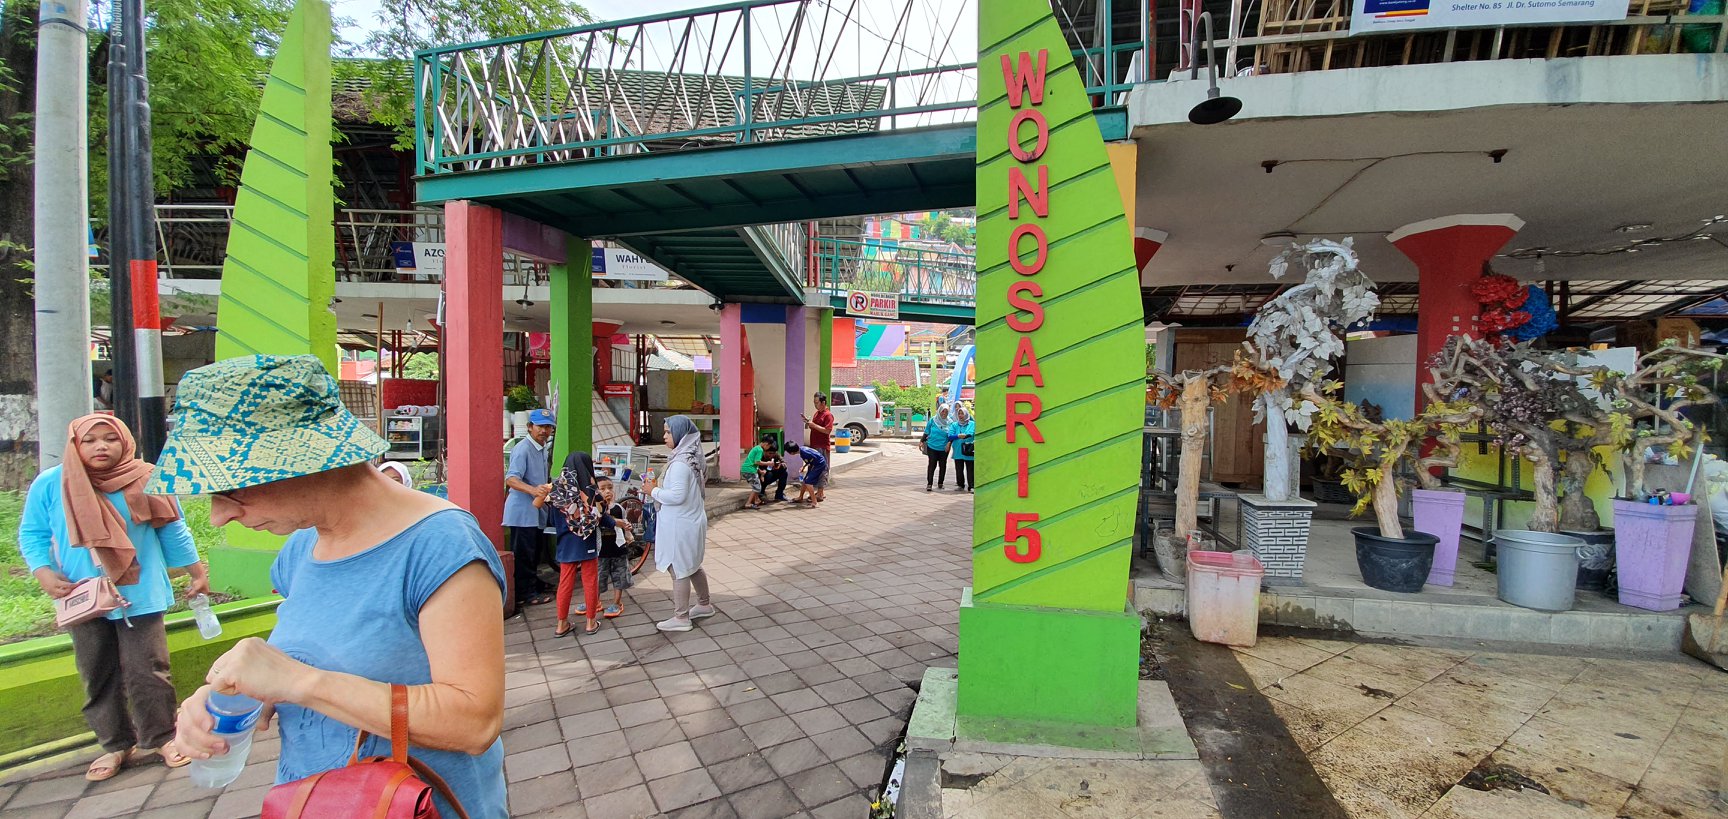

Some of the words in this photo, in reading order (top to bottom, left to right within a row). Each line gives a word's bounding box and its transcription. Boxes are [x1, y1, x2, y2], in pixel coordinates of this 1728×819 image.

[615, 254, 651, 263] WAHY
[1000, 49, 1049, 498] WONOSARI
[870, 298, 896, 309] PARKIR
[1004, 512, 1042, 563] 5
